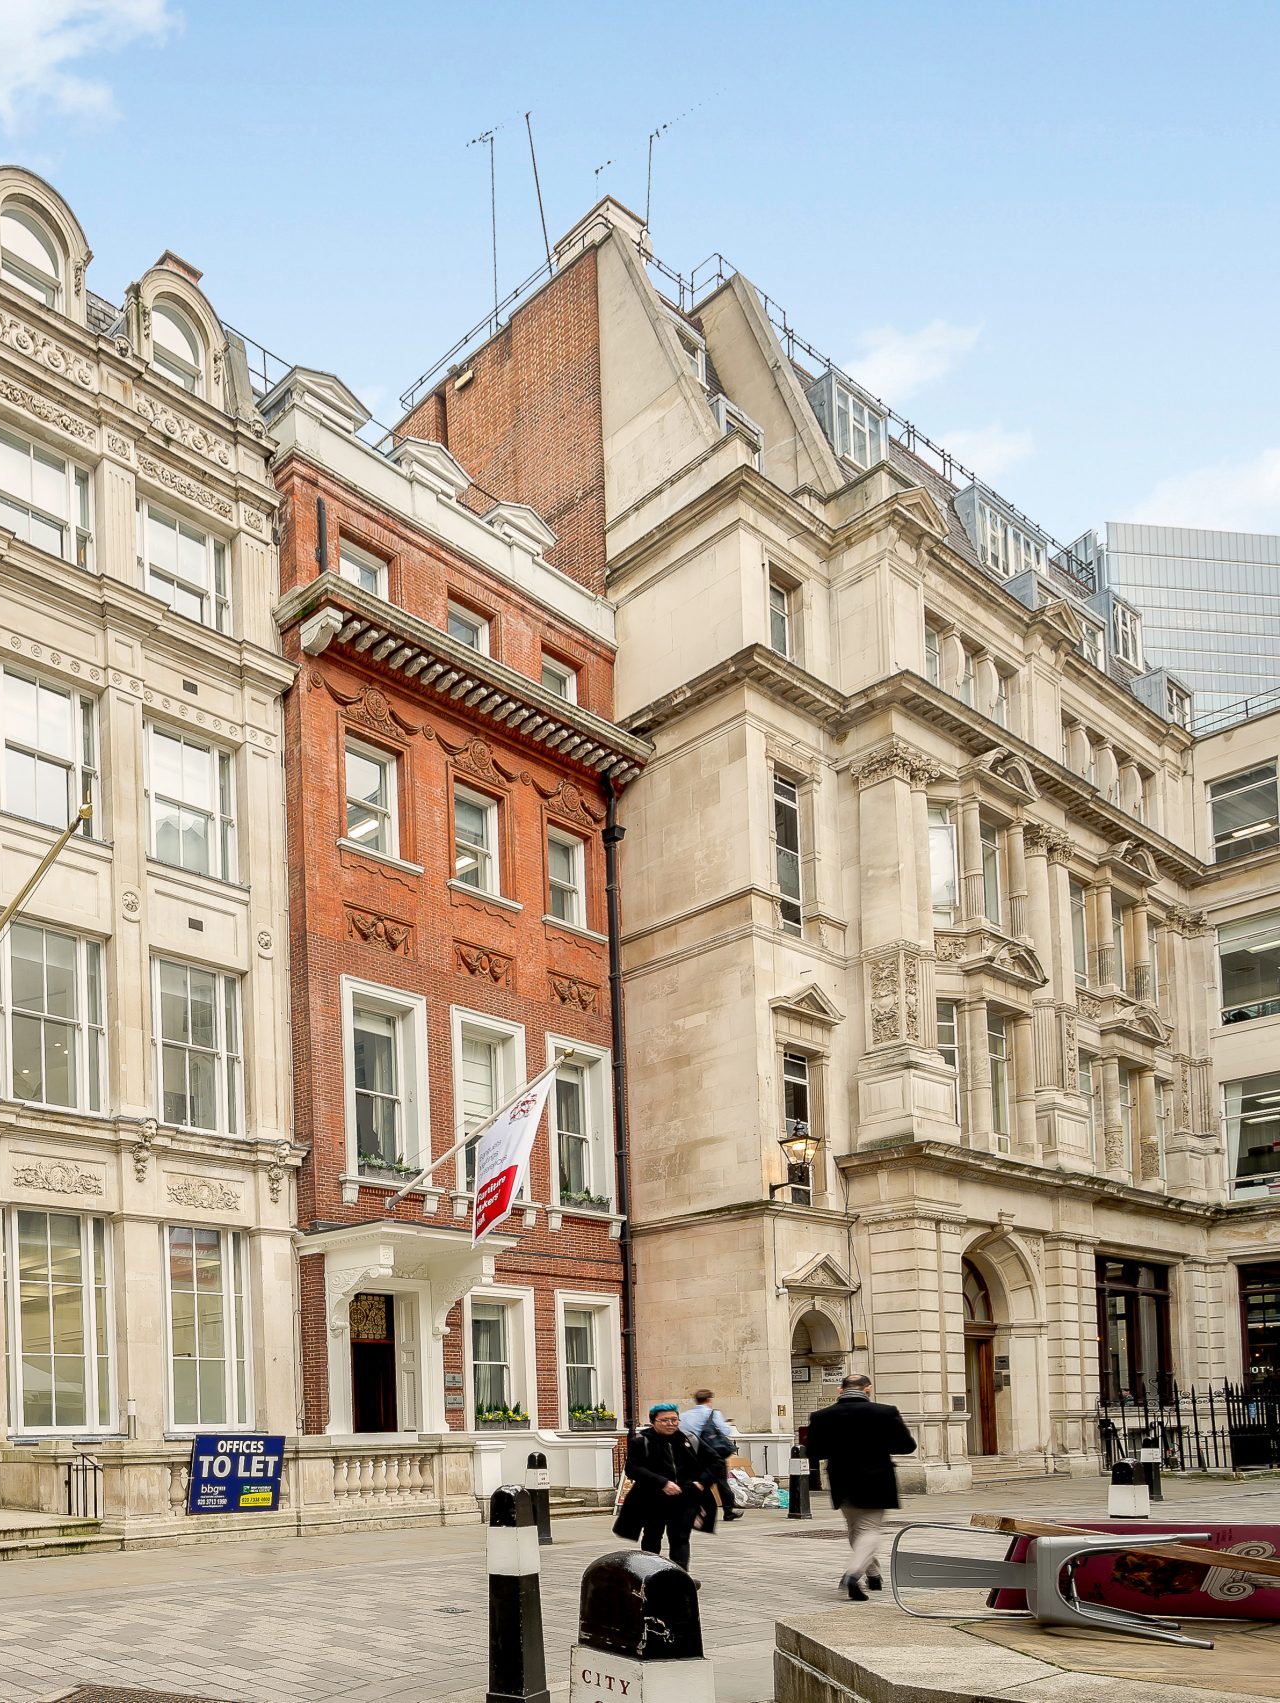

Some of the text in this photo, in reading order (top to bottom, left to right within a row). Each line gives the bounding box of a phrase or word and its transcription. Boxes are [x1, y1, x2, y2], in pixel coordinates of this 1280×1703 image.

[217, 1440, 264, 1453] OFFICES
[199, 1455, 279, 1478] TO LET
[581, 1669, 631, 1695] CITY
